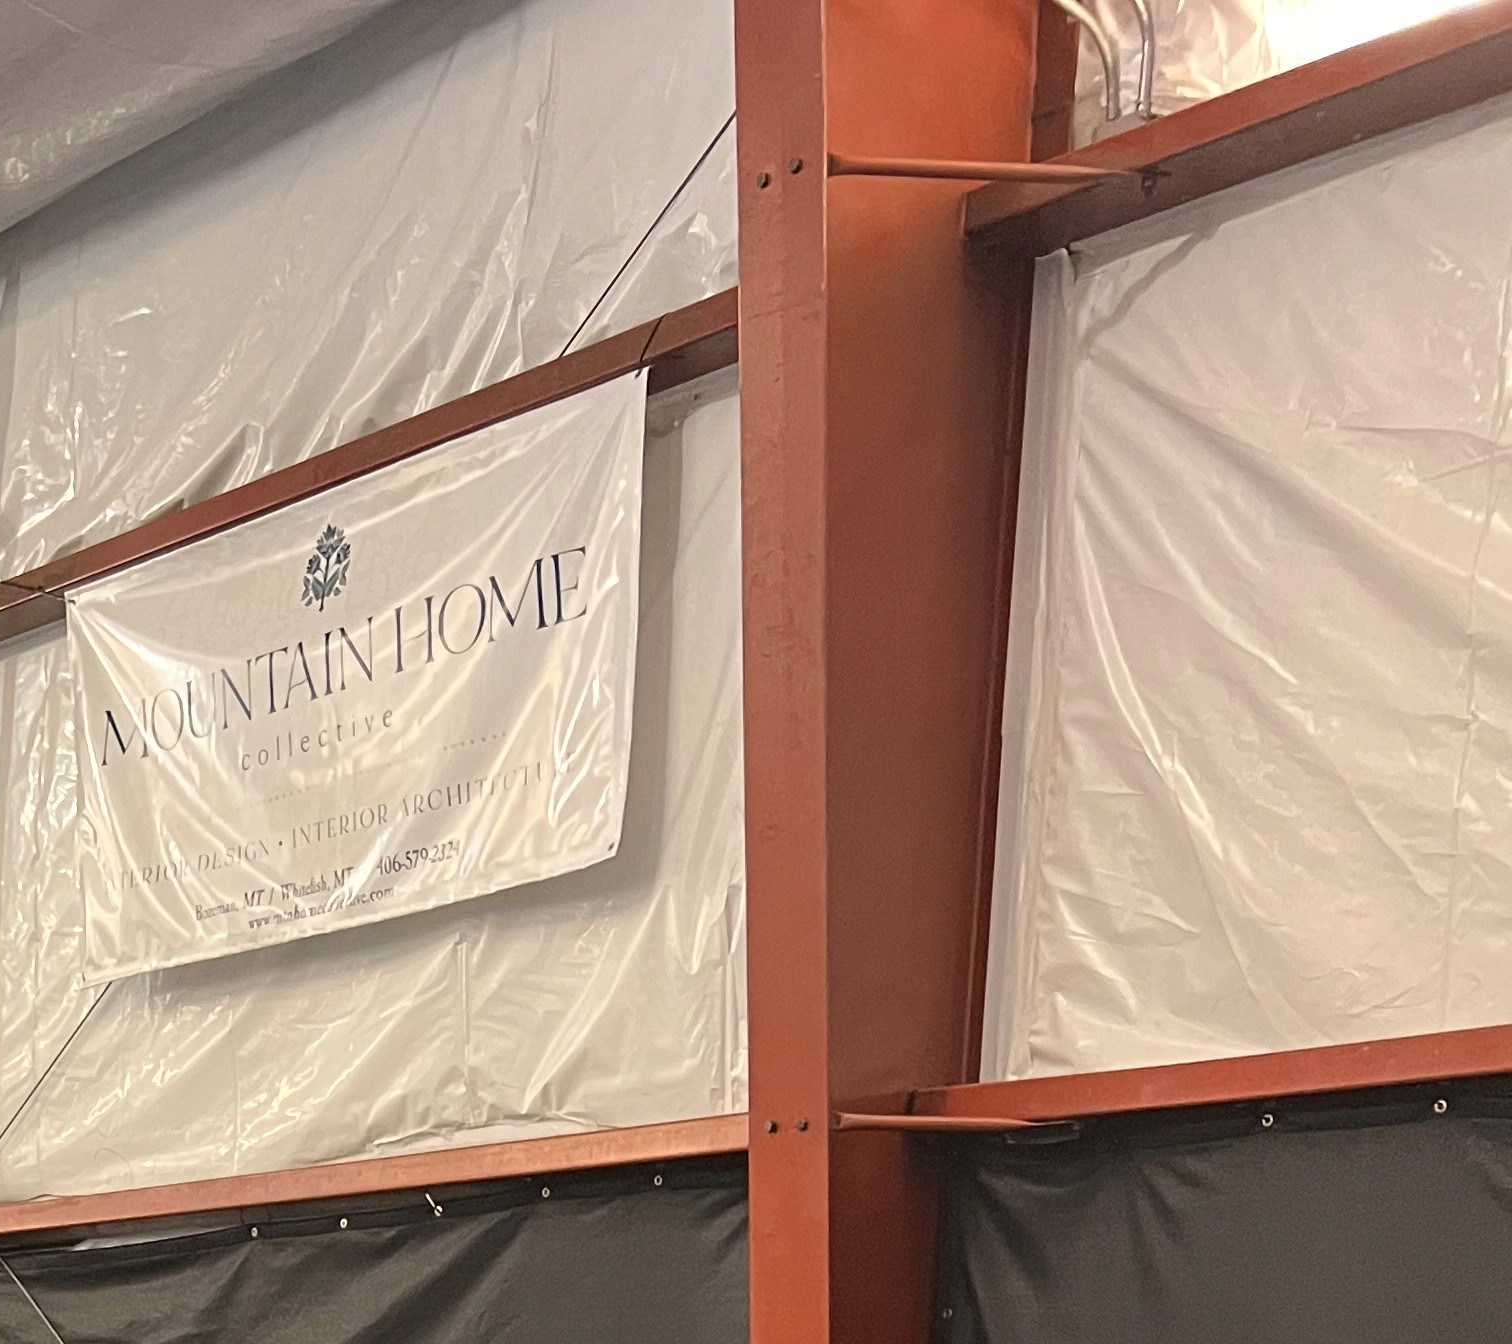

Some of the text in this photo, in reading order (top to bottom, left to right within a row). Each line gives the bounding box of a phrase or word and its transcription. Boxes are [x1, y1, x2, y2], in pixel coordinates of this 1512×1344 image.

[102, 547, 587, 766] MOUNTAIN HOME
[241, 710, 393, 771] collective
[198, 840, 270, 872] DESIGN
[292, 804, 388, 849] INTERIOR
[333, 865, 355, 889] MT
